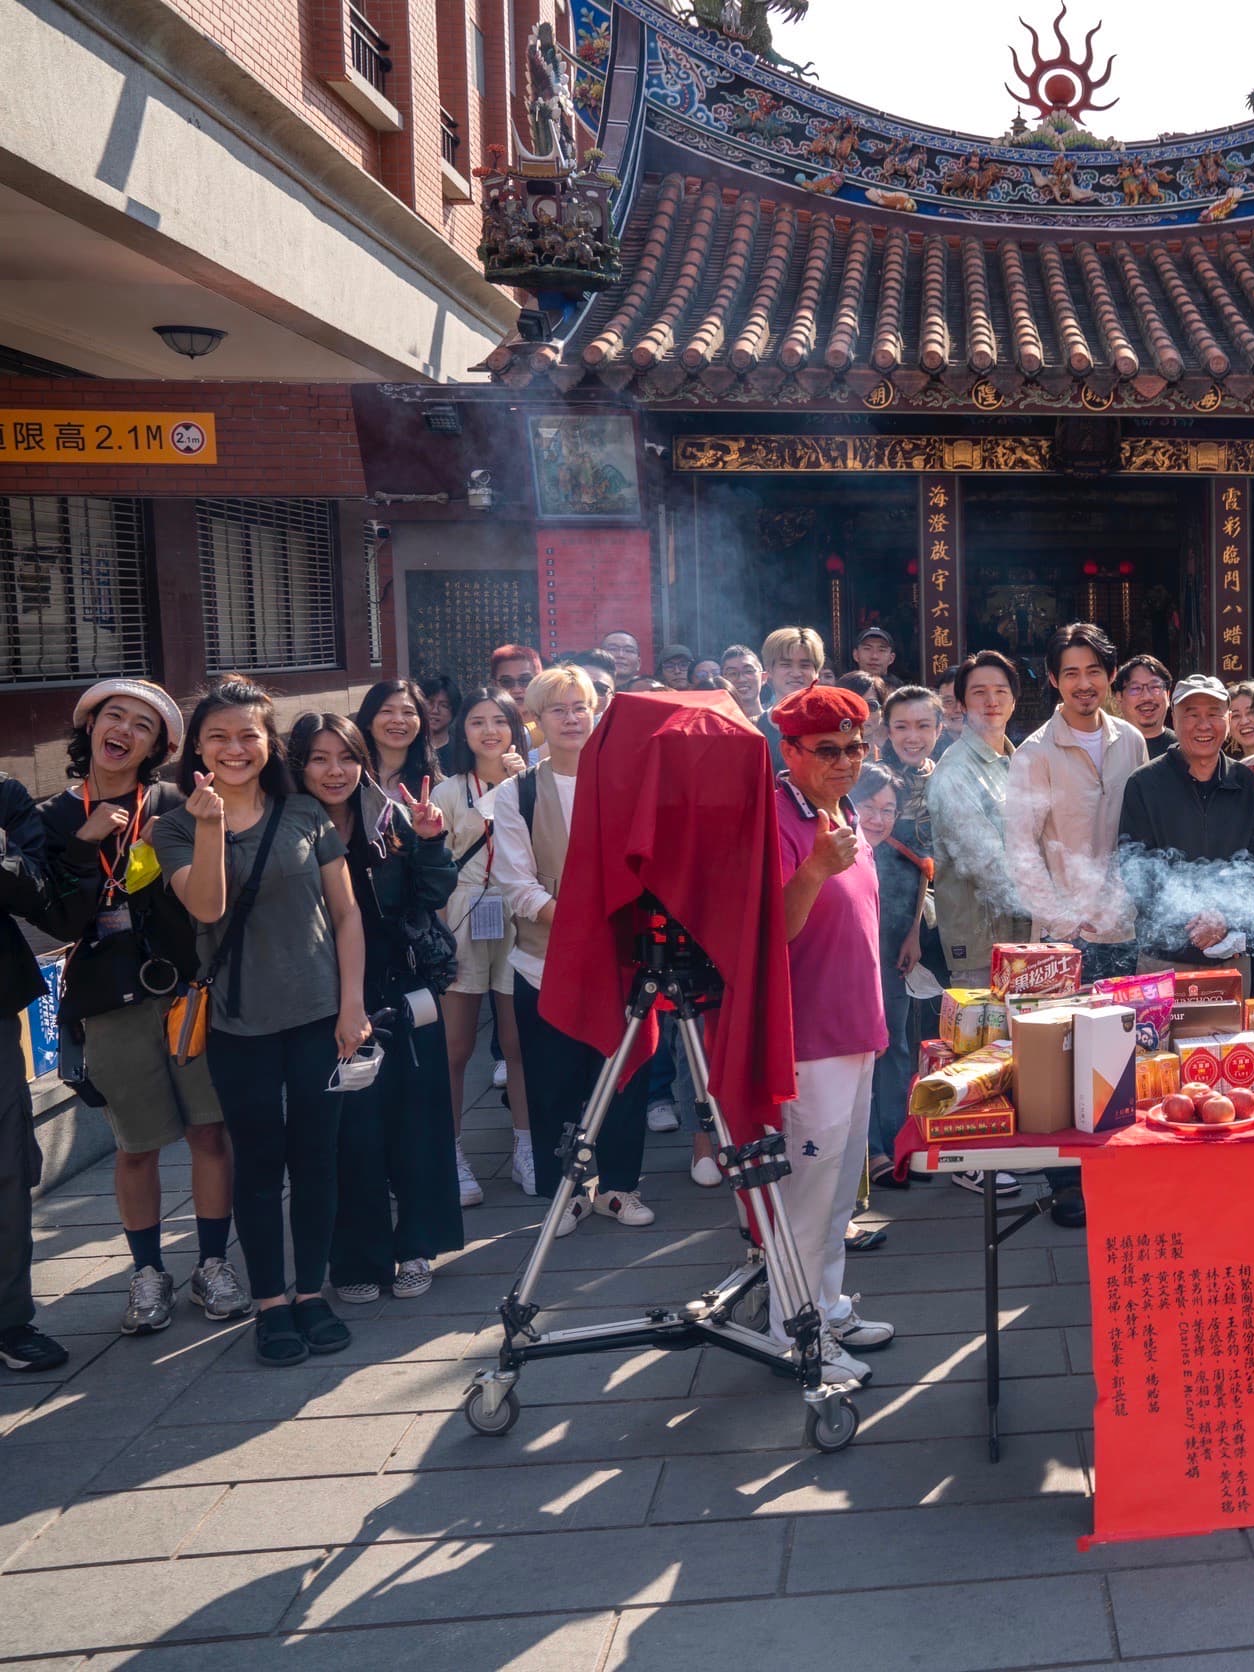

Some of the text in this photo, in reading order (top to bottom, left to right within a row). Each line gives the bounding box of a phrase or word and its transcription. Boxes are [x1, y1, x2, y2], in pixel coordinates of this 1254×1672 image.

[0, 421, 164, 452] 限高2.1M
[175, 432, 200, 444] 2.1m
[1222, 487, 1243, 688] 霞彩臨門八蜡配
